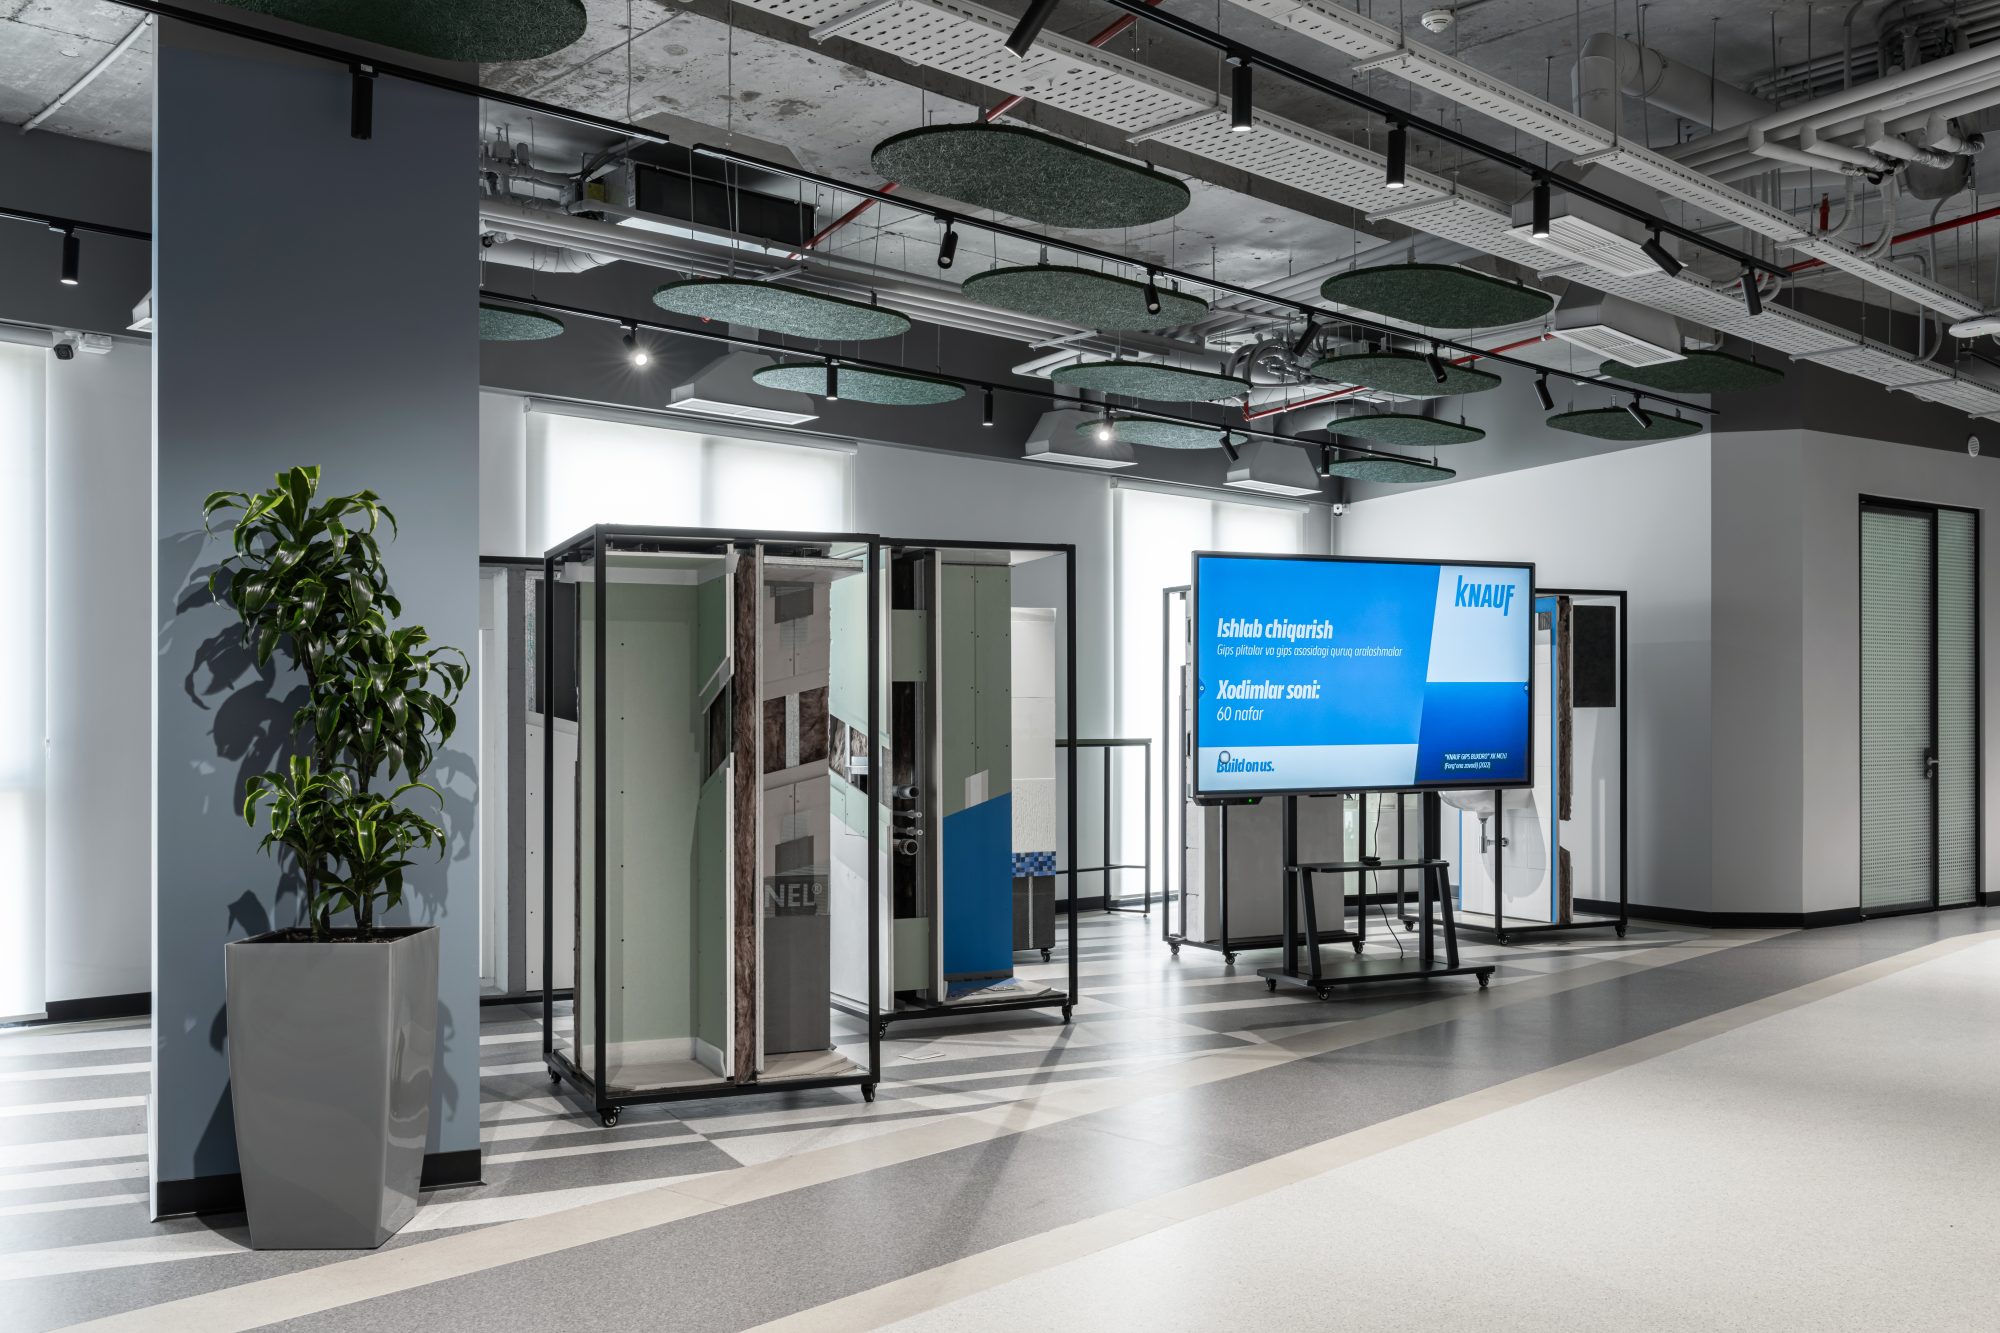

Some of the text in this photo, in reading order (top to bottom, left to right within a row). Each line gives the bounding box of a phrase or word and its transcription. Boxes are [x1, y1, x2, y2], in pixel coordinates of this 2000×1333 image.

[1455, 575, 1515, 616] KNAUF
[1217, 618, 1333, 642] Ishlab chiqarish
[1217, 644, 1403, 658] Gips plitalar va gips asosidagi quruq aralashmalar
[1216, 680, 1320, 699] Xodimlar soni:
[1216, 706, 1264, 721] 60 nafar
[1216, 756, 1275, 773] Build on us.
